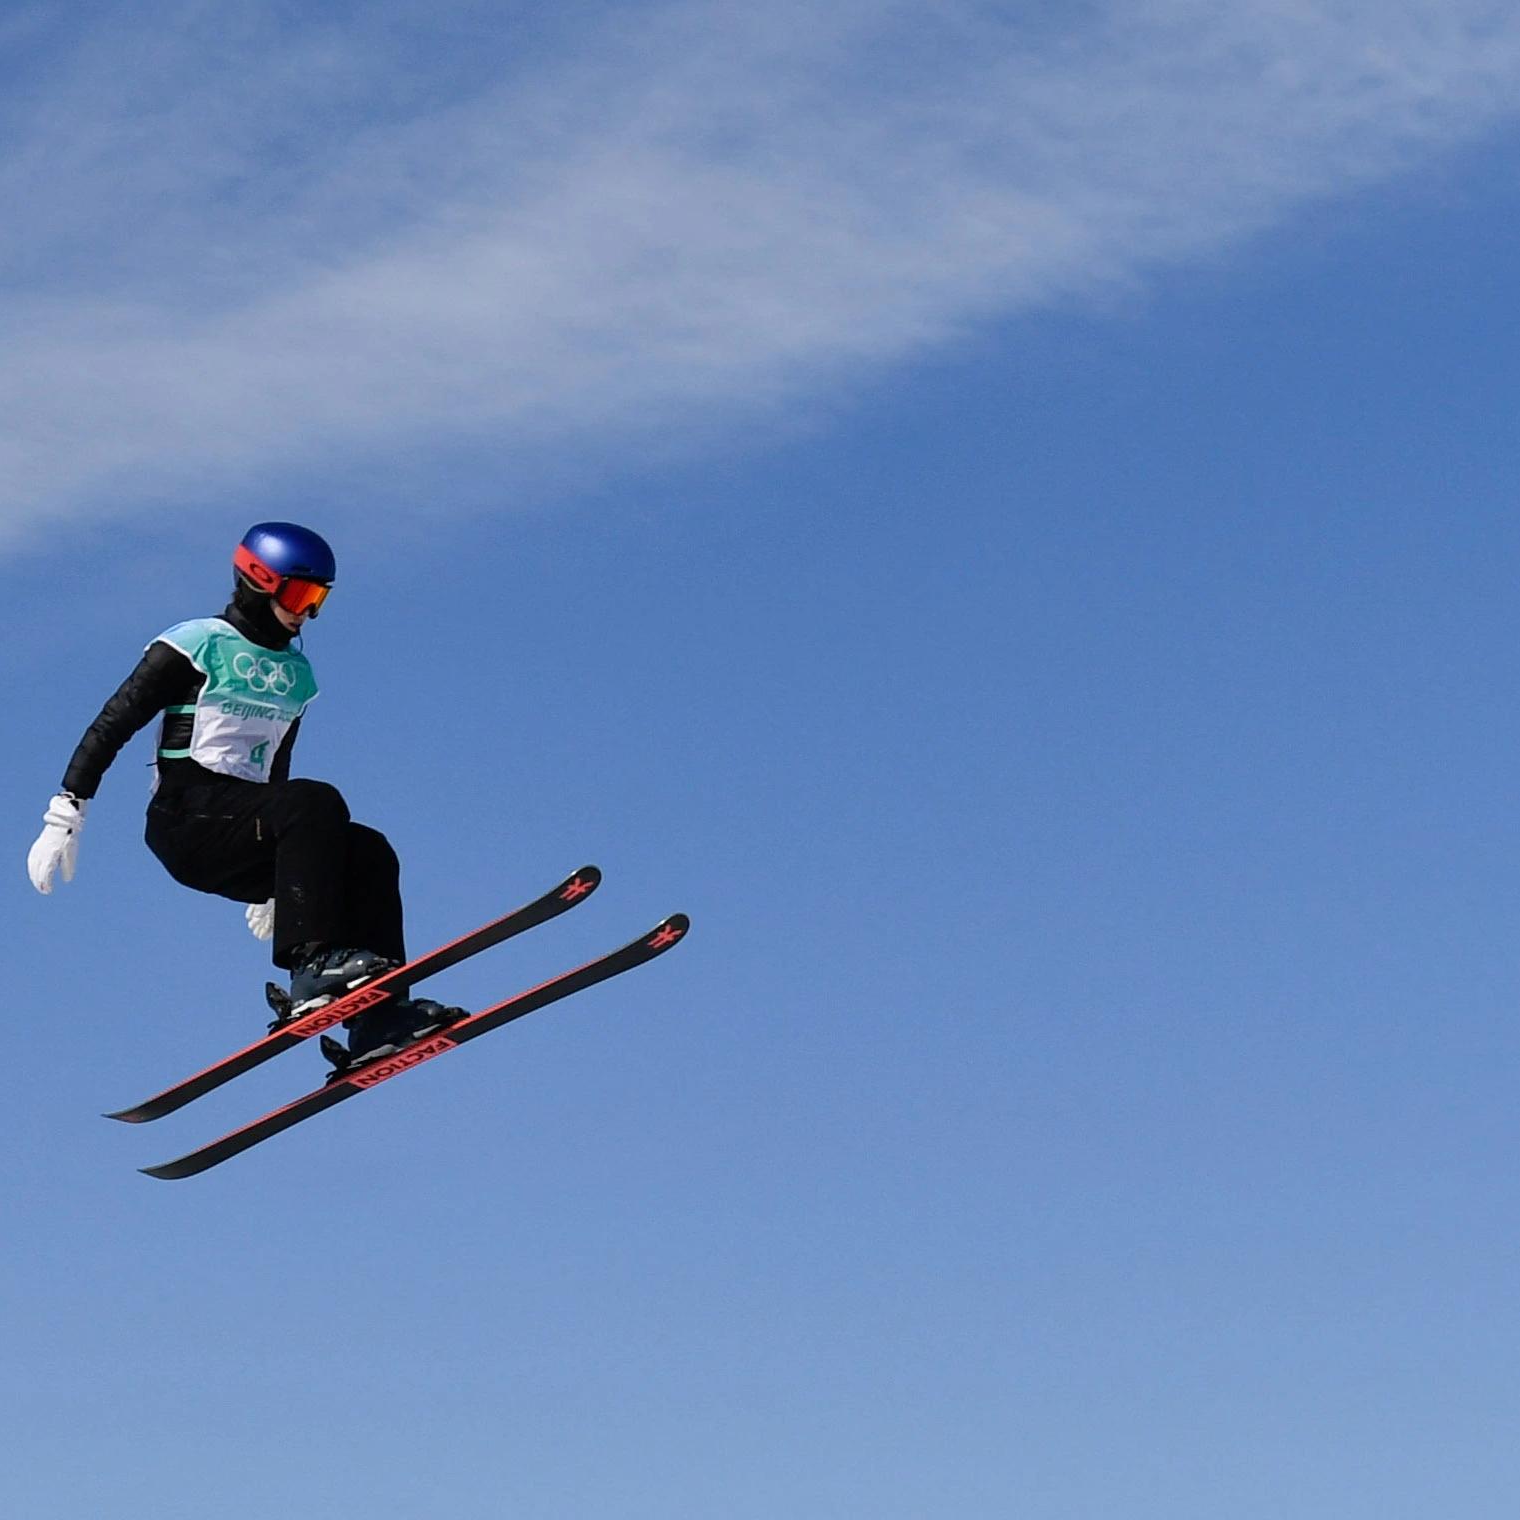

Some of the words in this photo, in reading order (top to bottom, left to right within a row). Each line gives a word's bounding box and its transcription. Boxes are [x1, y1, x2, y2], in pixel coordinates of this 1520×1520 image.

[221, 702, 274, 721] BEIJING
[299, 990, 384, 1036] FACTION
[357, 1038, 451, 1086] FACTION
